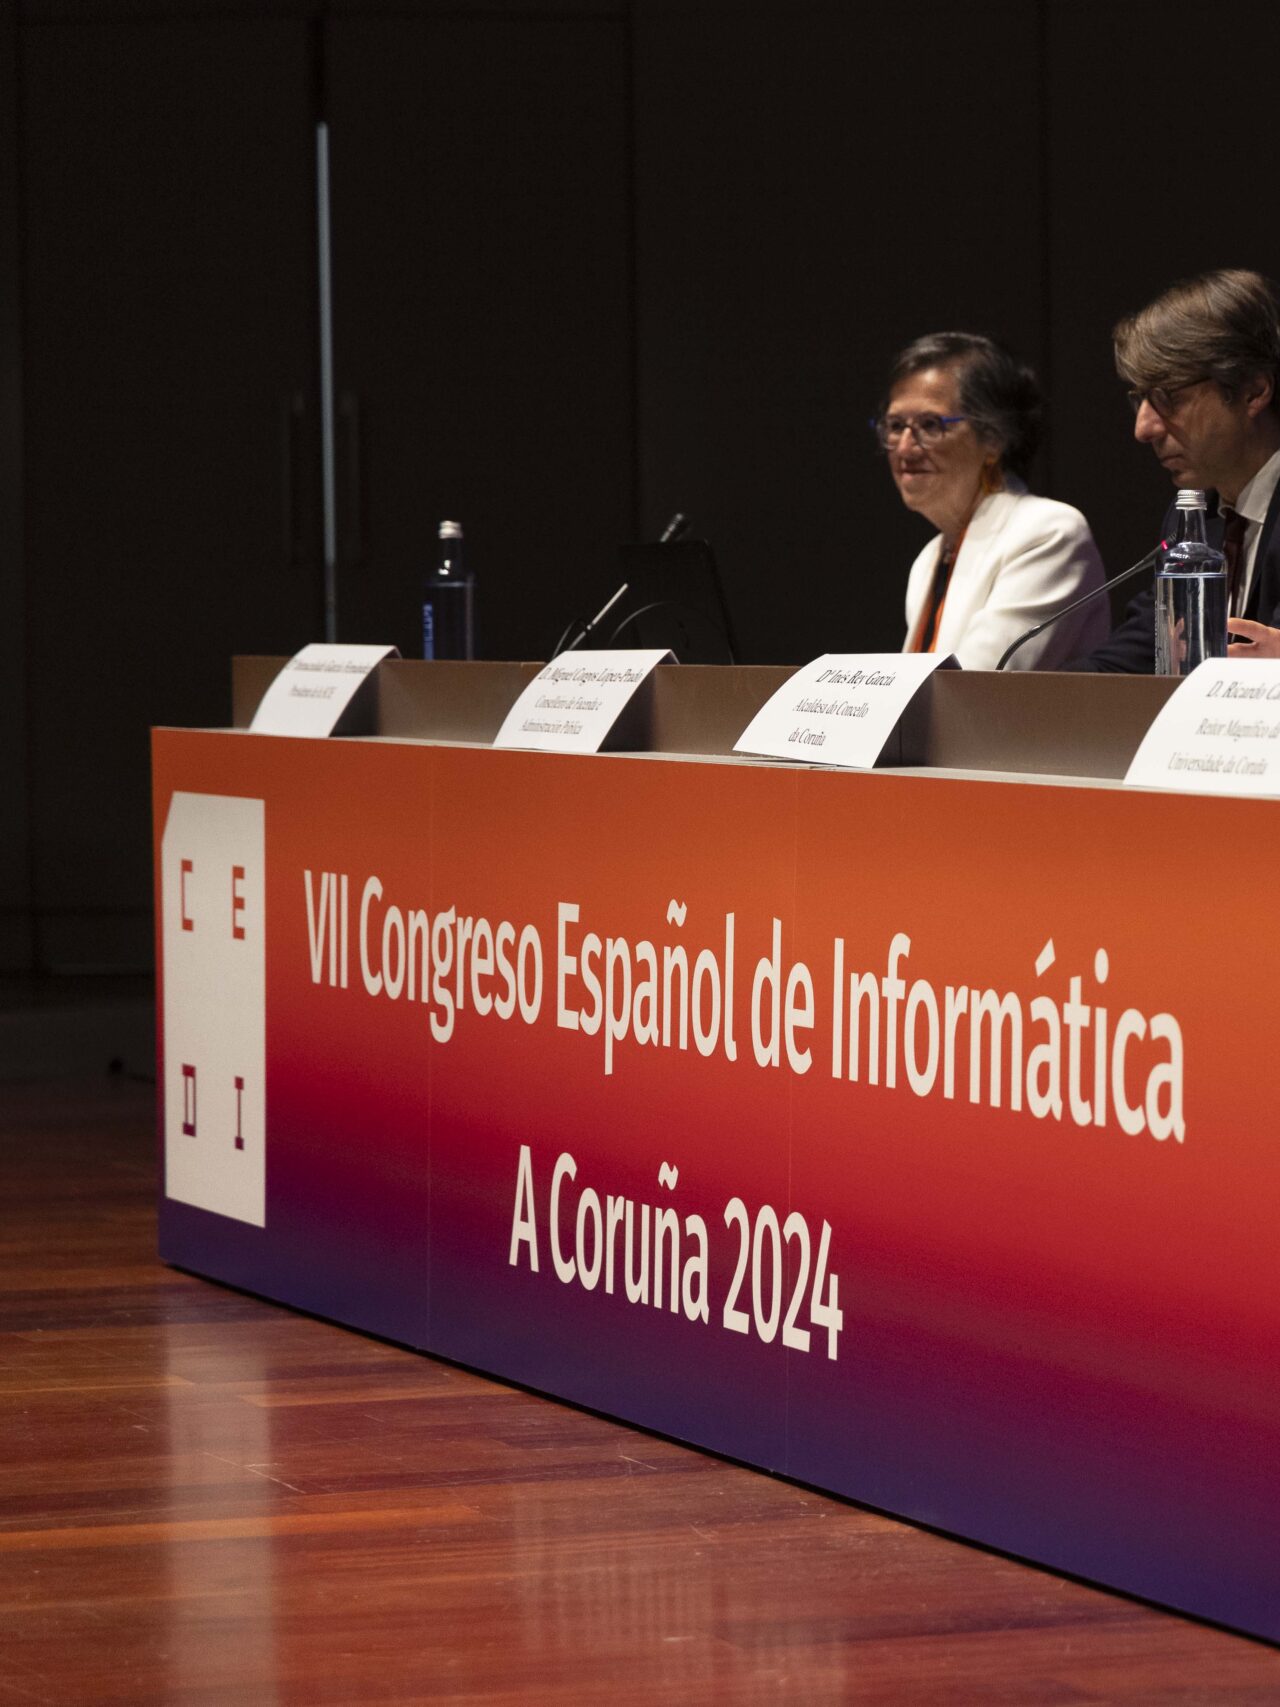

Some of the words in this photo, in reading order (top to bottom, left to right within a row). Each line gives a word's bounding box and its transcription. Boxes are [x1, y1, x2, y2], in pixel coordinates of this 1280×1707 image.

[848, 671, 866, 689] Rey
[304, 869, 349, 990] VII
[360, 876, 544, 1044] Congreso
[557, 899, 738, 1075] Español
[751, 917, 816, 1074] de
[831, 932, 1186, 1144] Informática
[508, 1144, 540, 1273] A
[550, 1152, 710, 1326] Coruña
[723, 1197, 844, 1362] 2024
